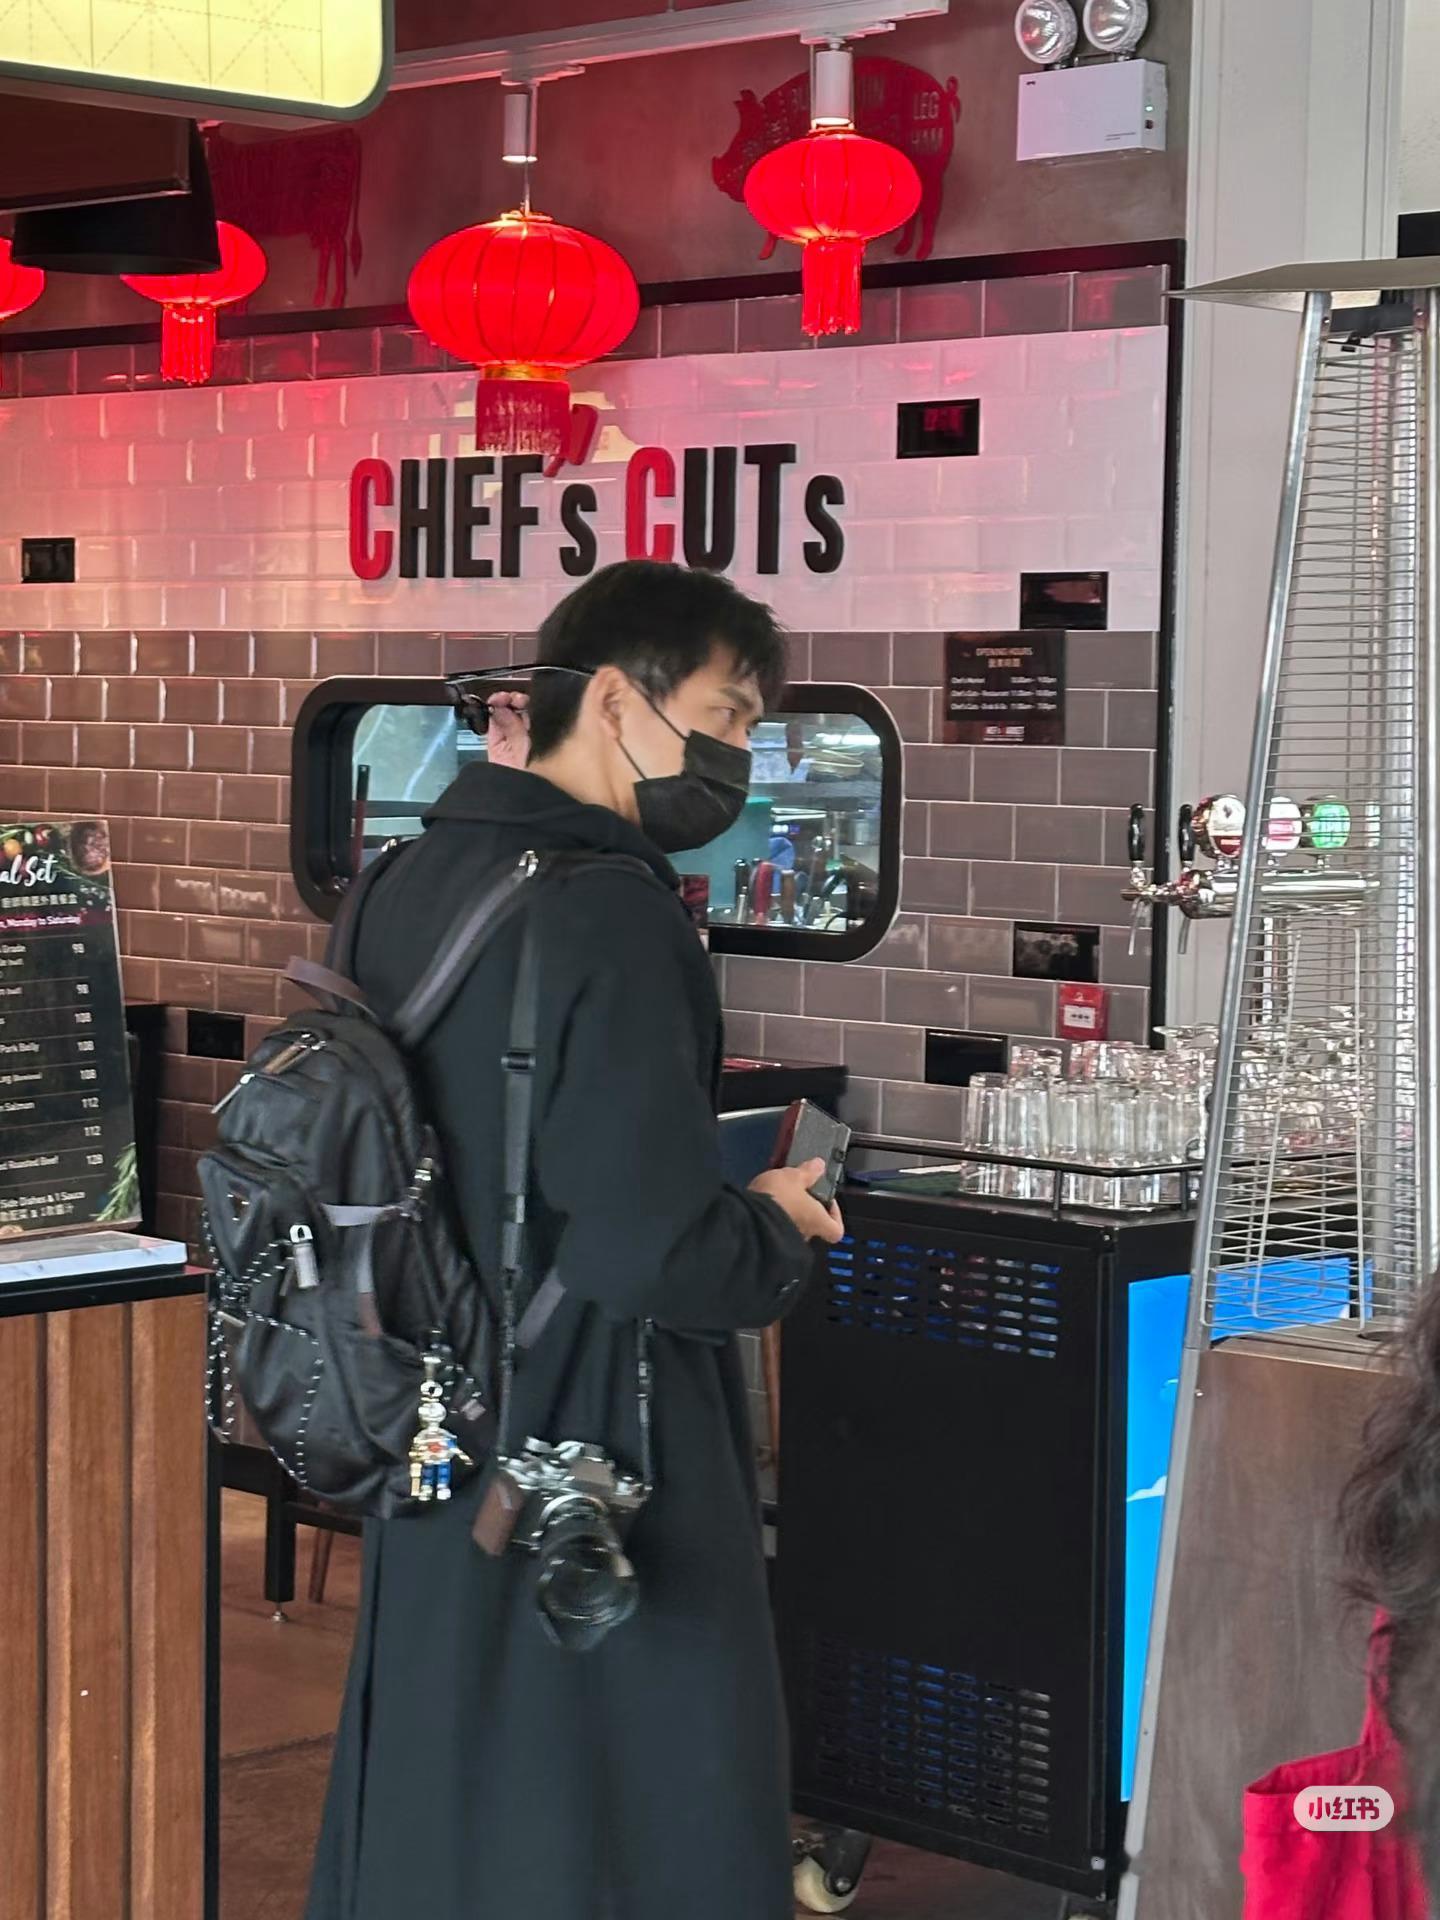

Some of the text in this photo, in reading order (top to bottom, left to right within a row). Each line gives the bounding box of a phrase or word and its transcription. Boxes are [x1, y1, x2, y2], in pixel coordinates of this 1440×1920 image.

[912, 91, 941, 120] LEG
[24, 854, 59, 886] Set
[81, 1097, 99, 1108] 112
[84, 1125, 102, 1137] 112
